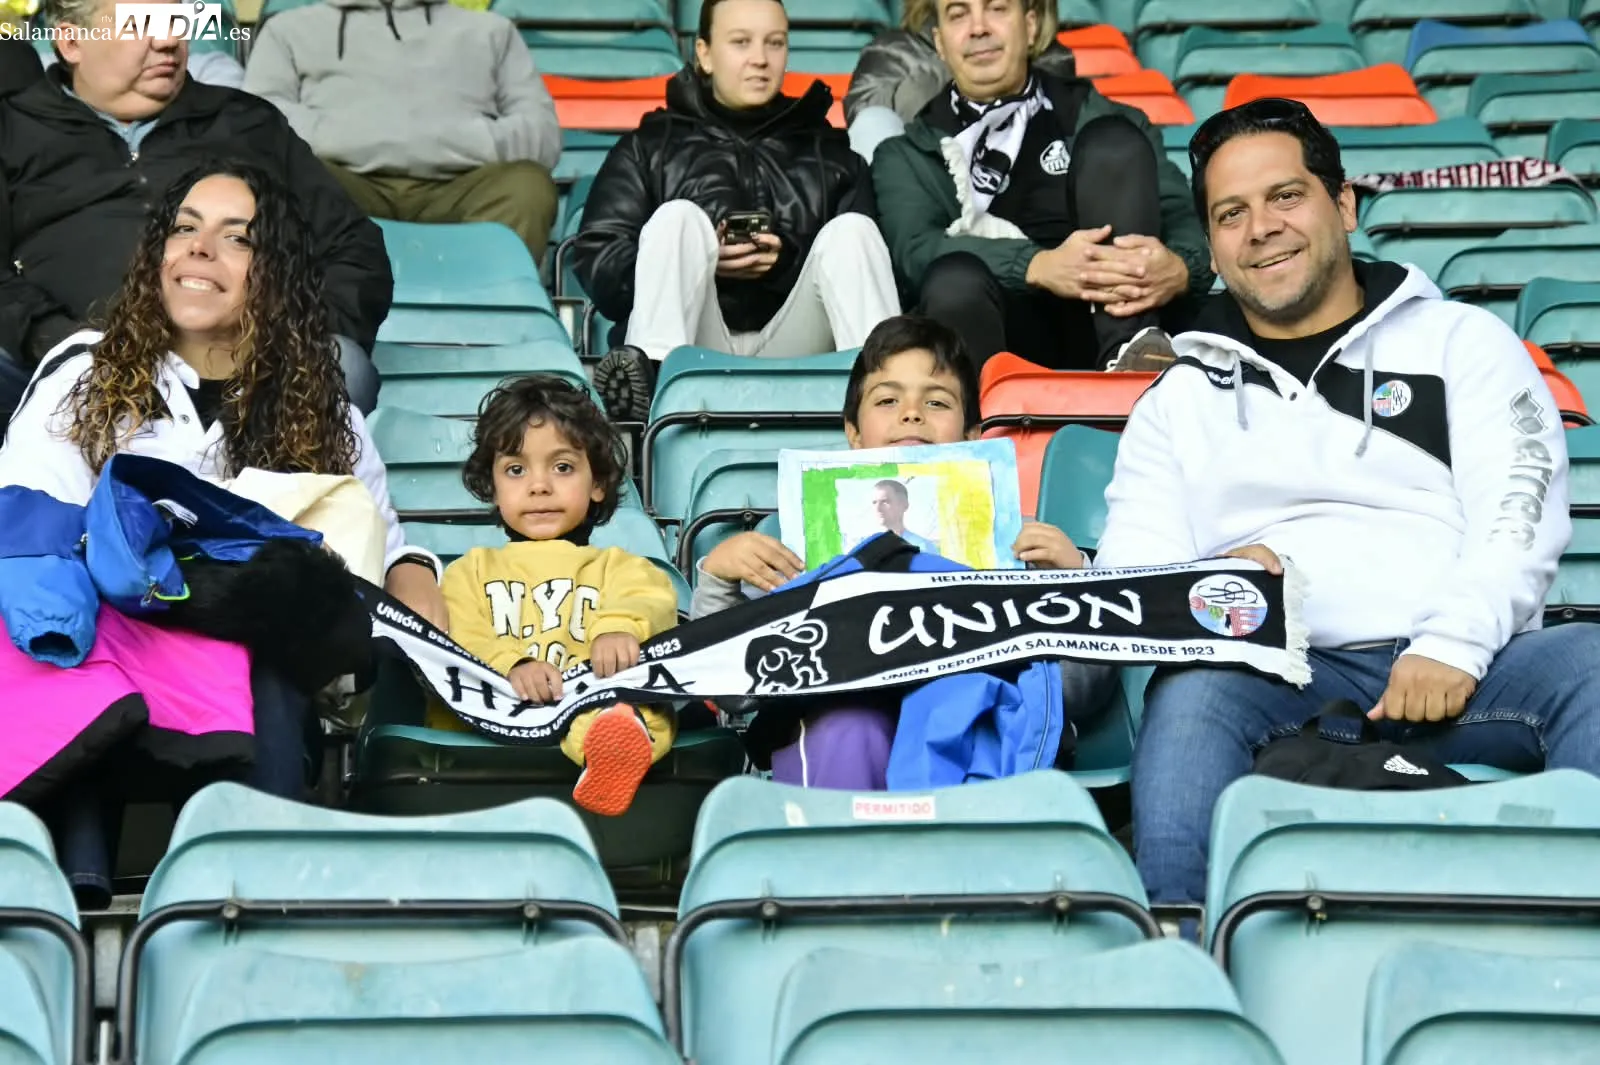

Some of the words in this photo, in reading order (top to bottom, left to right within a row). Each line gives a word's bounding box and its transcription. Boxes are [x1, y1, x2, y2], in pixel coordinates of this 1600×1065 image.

[376, 601, 423, 633] UNIÓN
[868, 590, 1143, 655] UNIÓN
[647, 638, 681, 658] 1923
[881, 667, 929, 681] UNIÓN
[937, 644, 1021, 671] DEPORTIVA
[1025, 638, 1121, 653] SALAMANCA
[1131, 643, 1177, 655] DESDE
[1180, 645, 1216, 656] 1923
[480, 721, 551, 738] CORAZÓN
[552, 690, 617, 731] UNIONISTA
[855, 802, 931, 815] PERMITIDO
